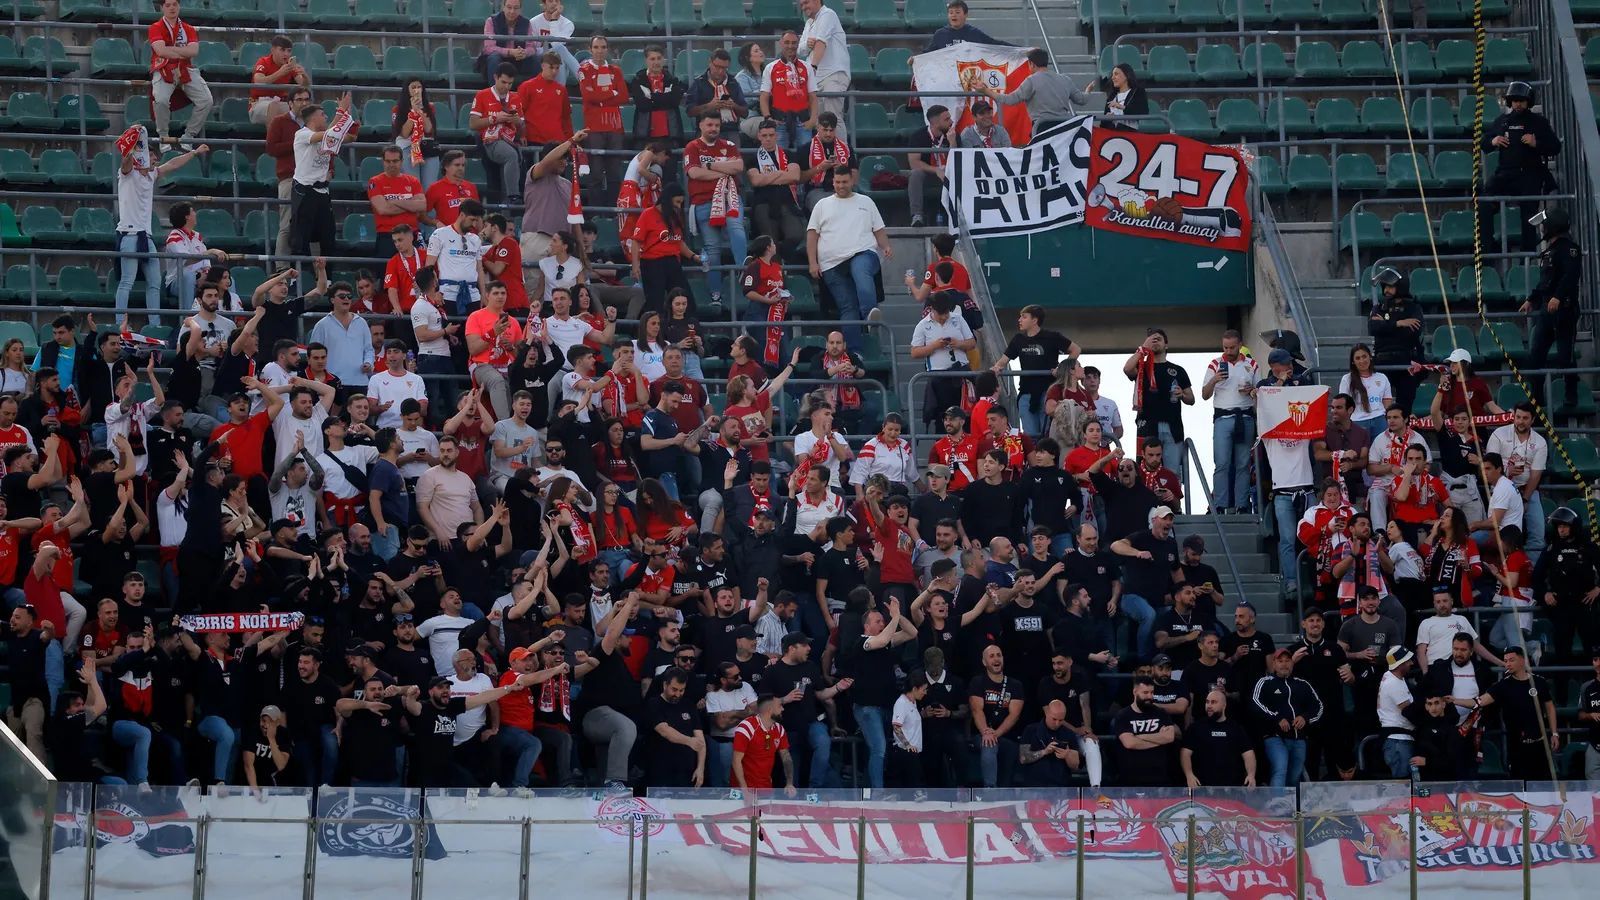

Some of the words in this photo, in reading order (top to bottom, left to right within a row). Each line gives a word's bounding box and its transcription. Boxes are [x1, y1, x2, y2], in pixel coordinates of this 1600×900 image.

[975, 168, 1061, 195] DONDE
[1100, 138, 1238, 209] 24-7
[1109, 210, 1175, 234] Kanallas
[1178, 217, 1221, 242] away
[1409, 416, 1453, 428] SEVILA
[196, 612, 235, 630] BIRIS
[240, 610, 288, 629] NORTE
[1015, 617, 1042, 630] KS91
[1130, 718, 1160, 733] 1975
[707, 815, 1026, 861] SEVILLA
